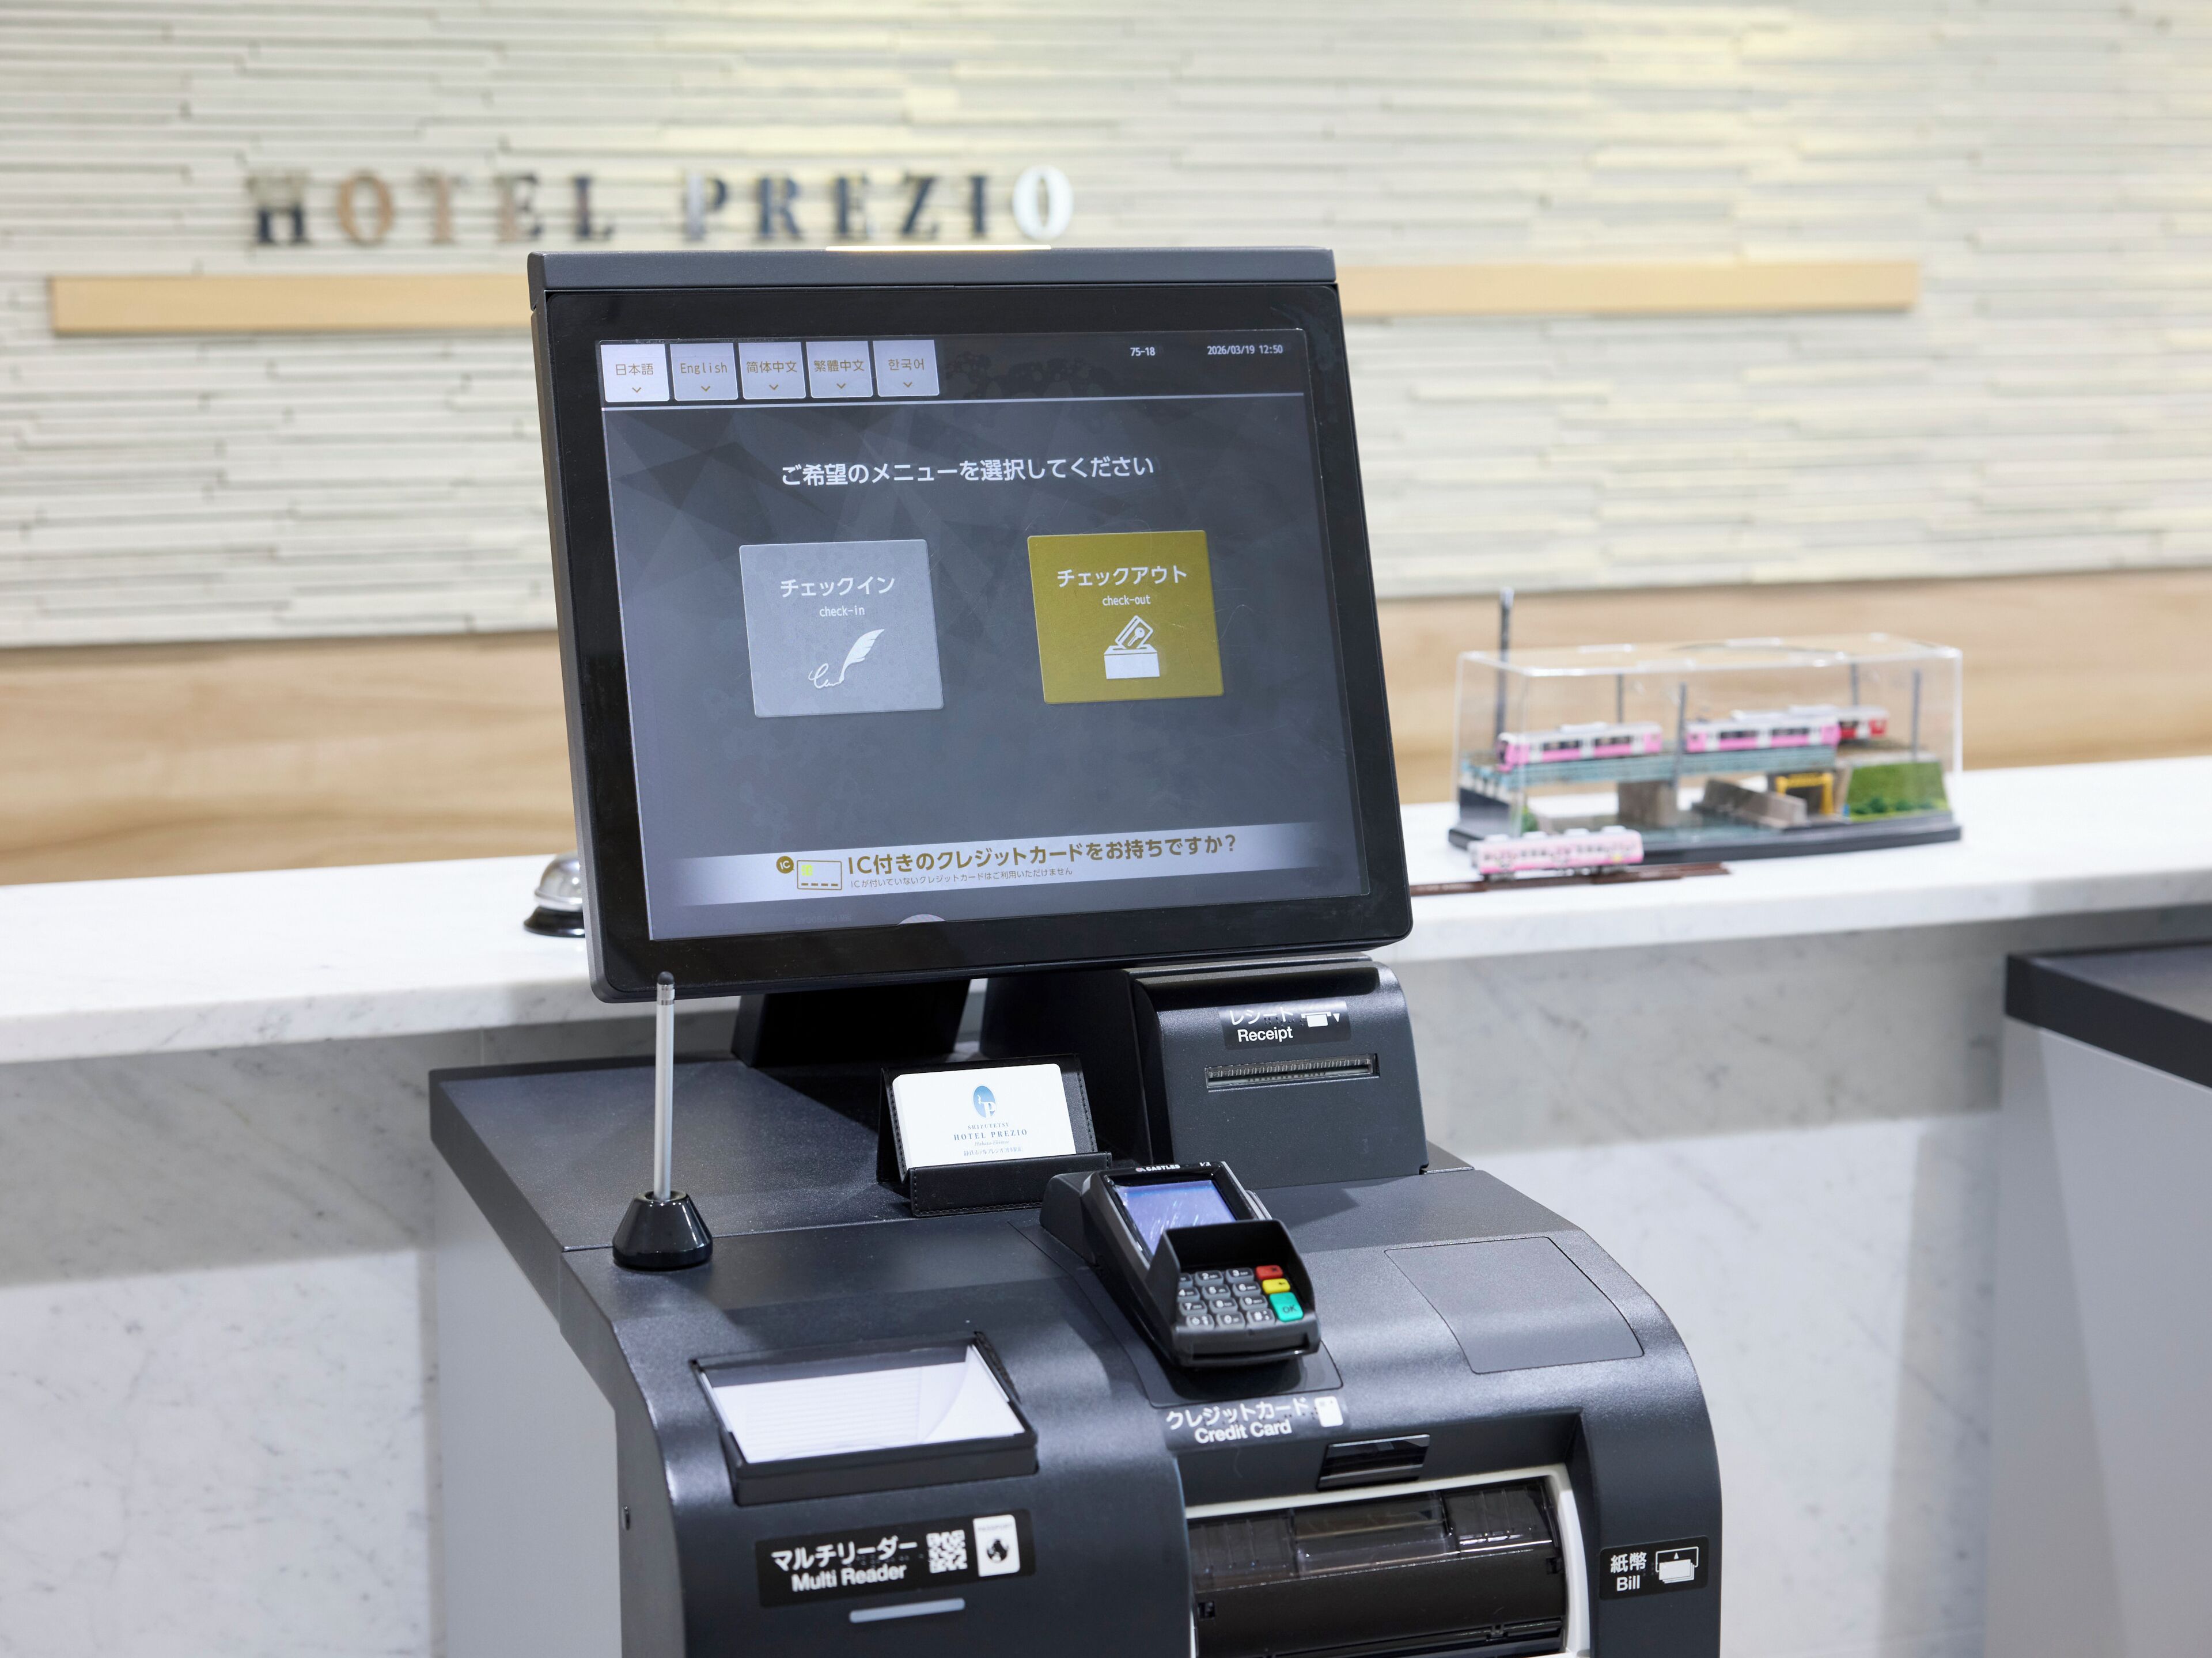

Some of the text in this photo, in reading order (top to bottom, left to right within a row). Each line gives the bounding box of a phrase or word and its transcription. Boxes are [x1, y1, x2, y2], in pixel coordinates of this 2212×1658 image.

[248, 165, 1074, 246] HOTEL PREZIO
[1130, 347, 1156, 356] 75-18
[1207, 344, 1283, 355] 2026/03/19 12:50
[615, 363, 654, 375] 日本語
[680, 362, 728, 374] English
[746, 361, 798, 374] 简体中文
[813, 359, 865, 373] 繁體中文
[888, 358, 925, 371] 한국어
[781, 456, 1154, 487] ご希望のメニューを選択してください
[1056, 564, 1187, 588] チェックアウト
[780, 575, 895, 598] チェックイン
[1102, 594, 1151, 606] check-out
[819, 605, 866, 617] check-in
[850, 867, 1073, 889] ICが付いていないクレジットカードはご利用いただけません
[1229, 1006, 1294, 1025] レシート
[1237, 1026, 1294, 1042] Receipt
[954, 1129, 1027, 1140] HOTEL PREZIO
[1146, 1164, 1181, 1172] CASTLES
[1282, 1304, 1297, 1314] OK
[1165, 1397, 1309, 1431] クレジットカード
[1194, 1418, 1292, 1444] Credit Card
[771, 1535, 918, 1572] マルチリーダー
[1610, 1551, 1647, 1573] 紙幣
[791, 1564, 907, 1592] Multi Reader
[1616, 1574, 1641, 1592] Bill
